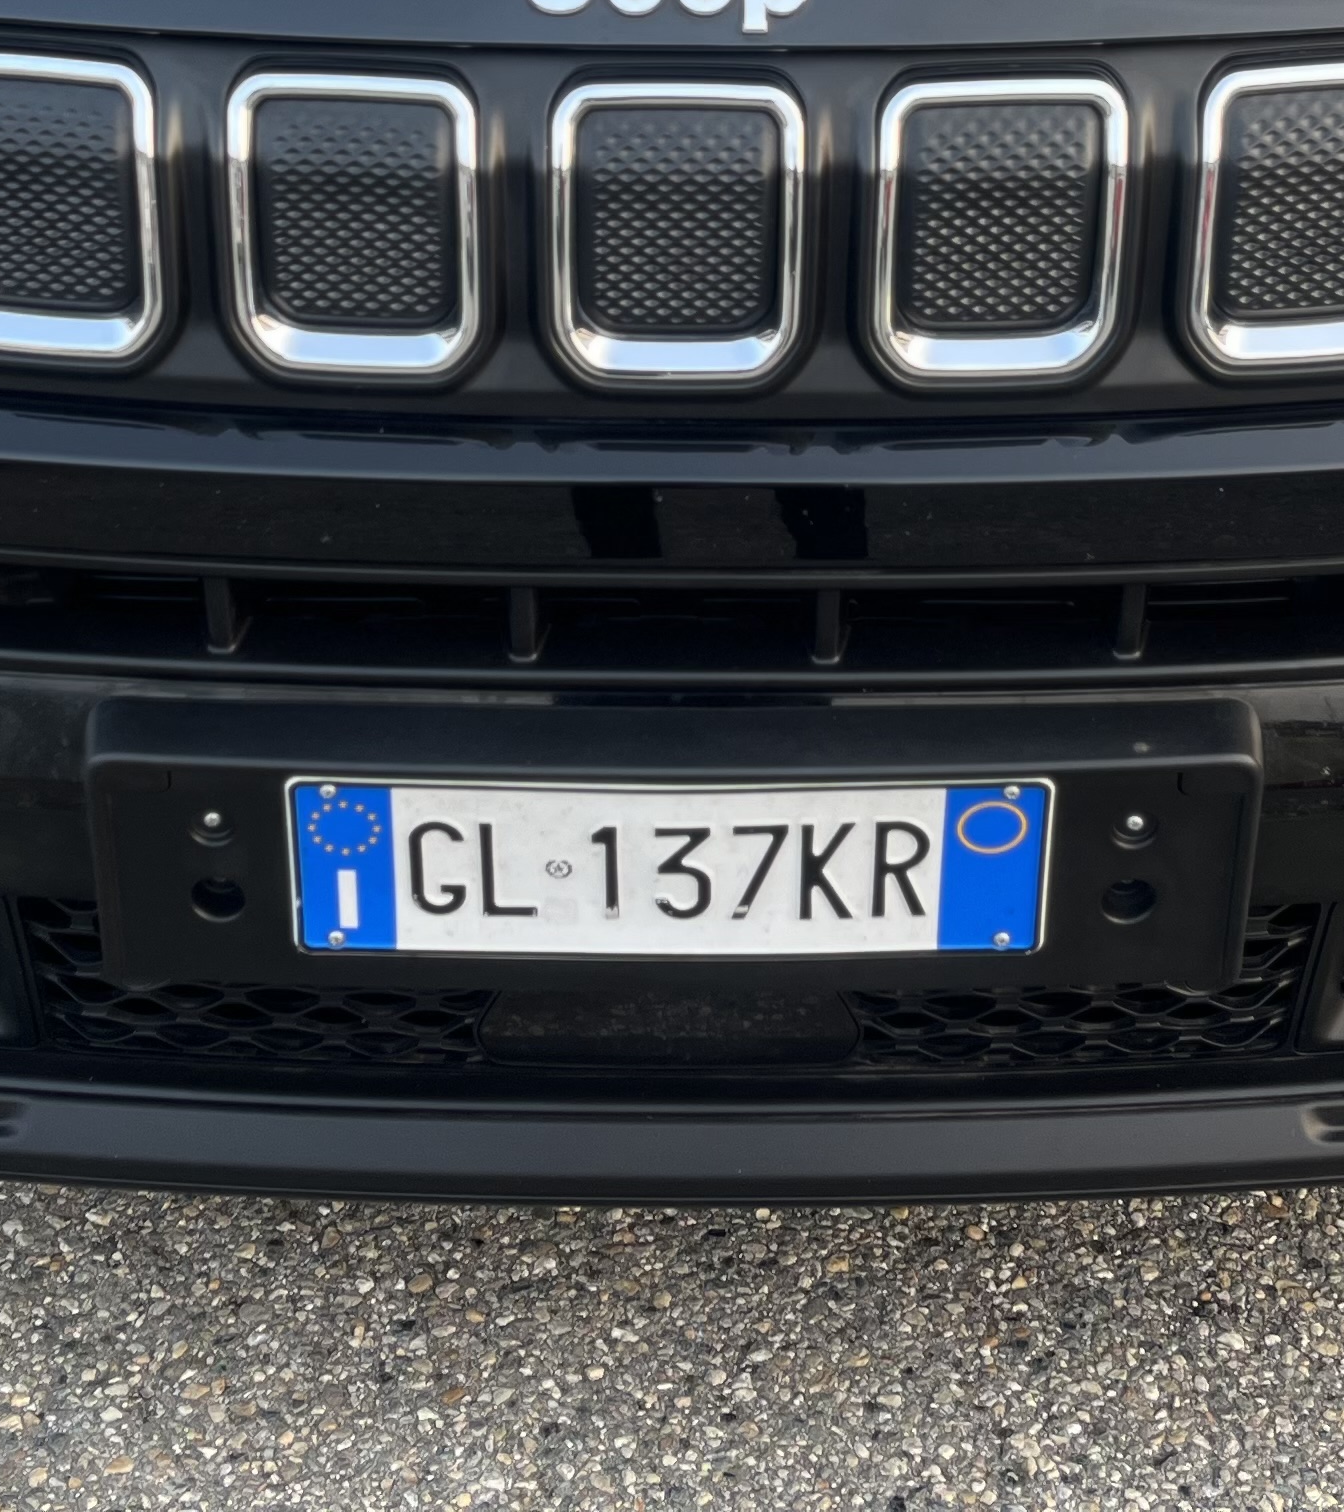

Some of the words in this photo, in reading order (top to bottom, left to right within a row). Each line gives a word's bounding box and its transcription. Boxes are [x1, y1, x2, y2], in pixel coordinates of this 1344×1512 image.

[337, 869, 359, 929] I
[408, 821, 538, 917] GL
[591, 821, 931, 920] 137KR
